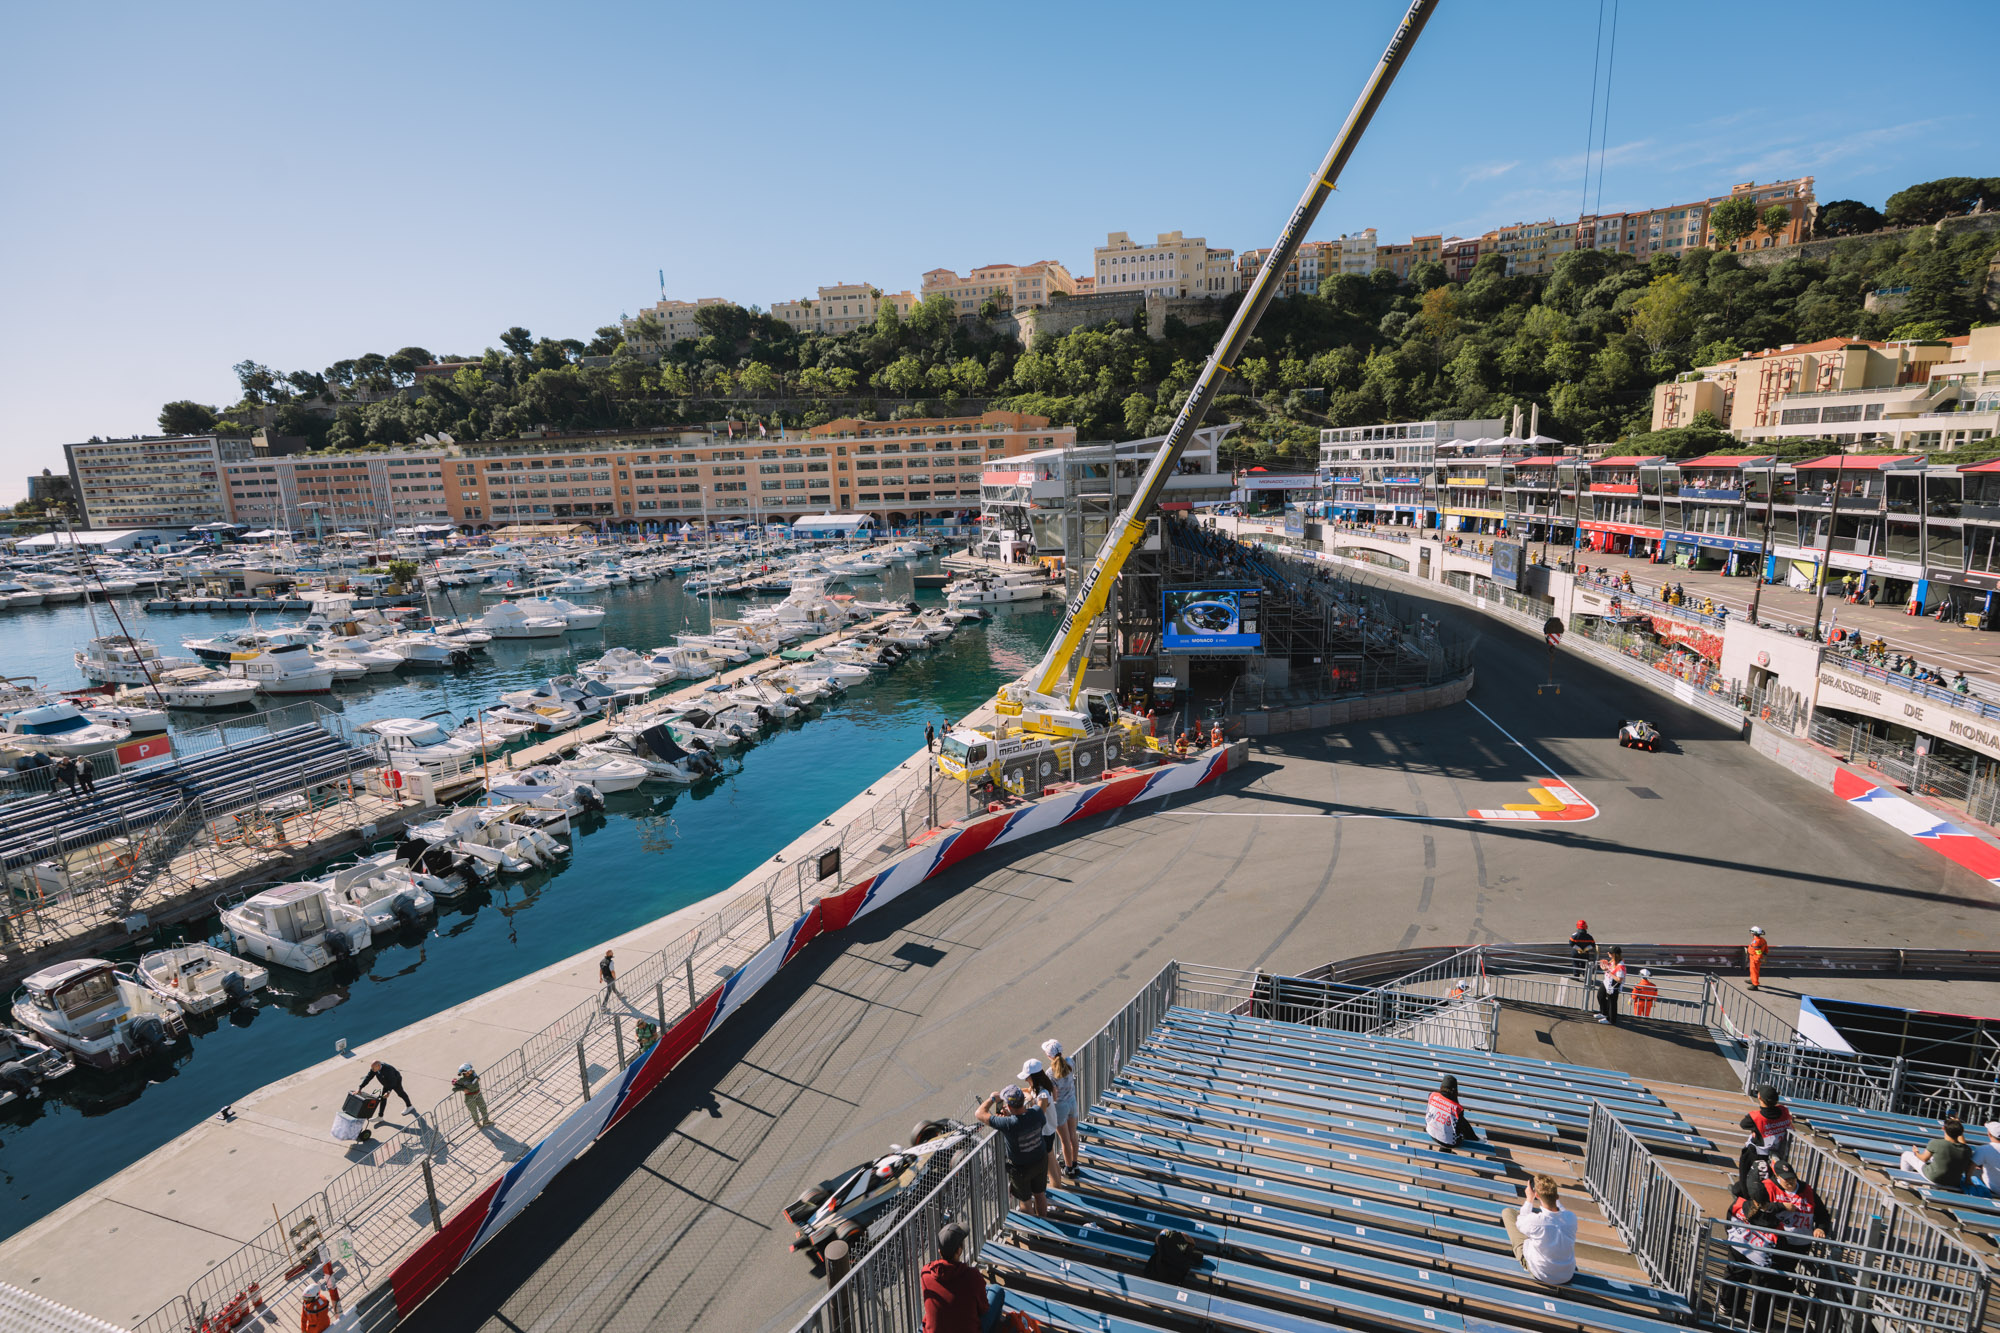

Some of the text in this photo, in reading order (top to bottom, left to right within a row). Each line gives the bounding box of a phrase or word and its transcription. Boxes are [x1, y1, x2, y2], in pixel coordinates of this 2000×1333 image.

[1381, 0, 1425, 64] MEDIAC
[1820, 672, 1882, 706] BRASSERIE
[1903, 703, 1924, 722] DE
[138, 744, 150, 758] P
[1435, 1111, 1452, 1127] 259
[1792, 1213, 1811, 1230] 274
